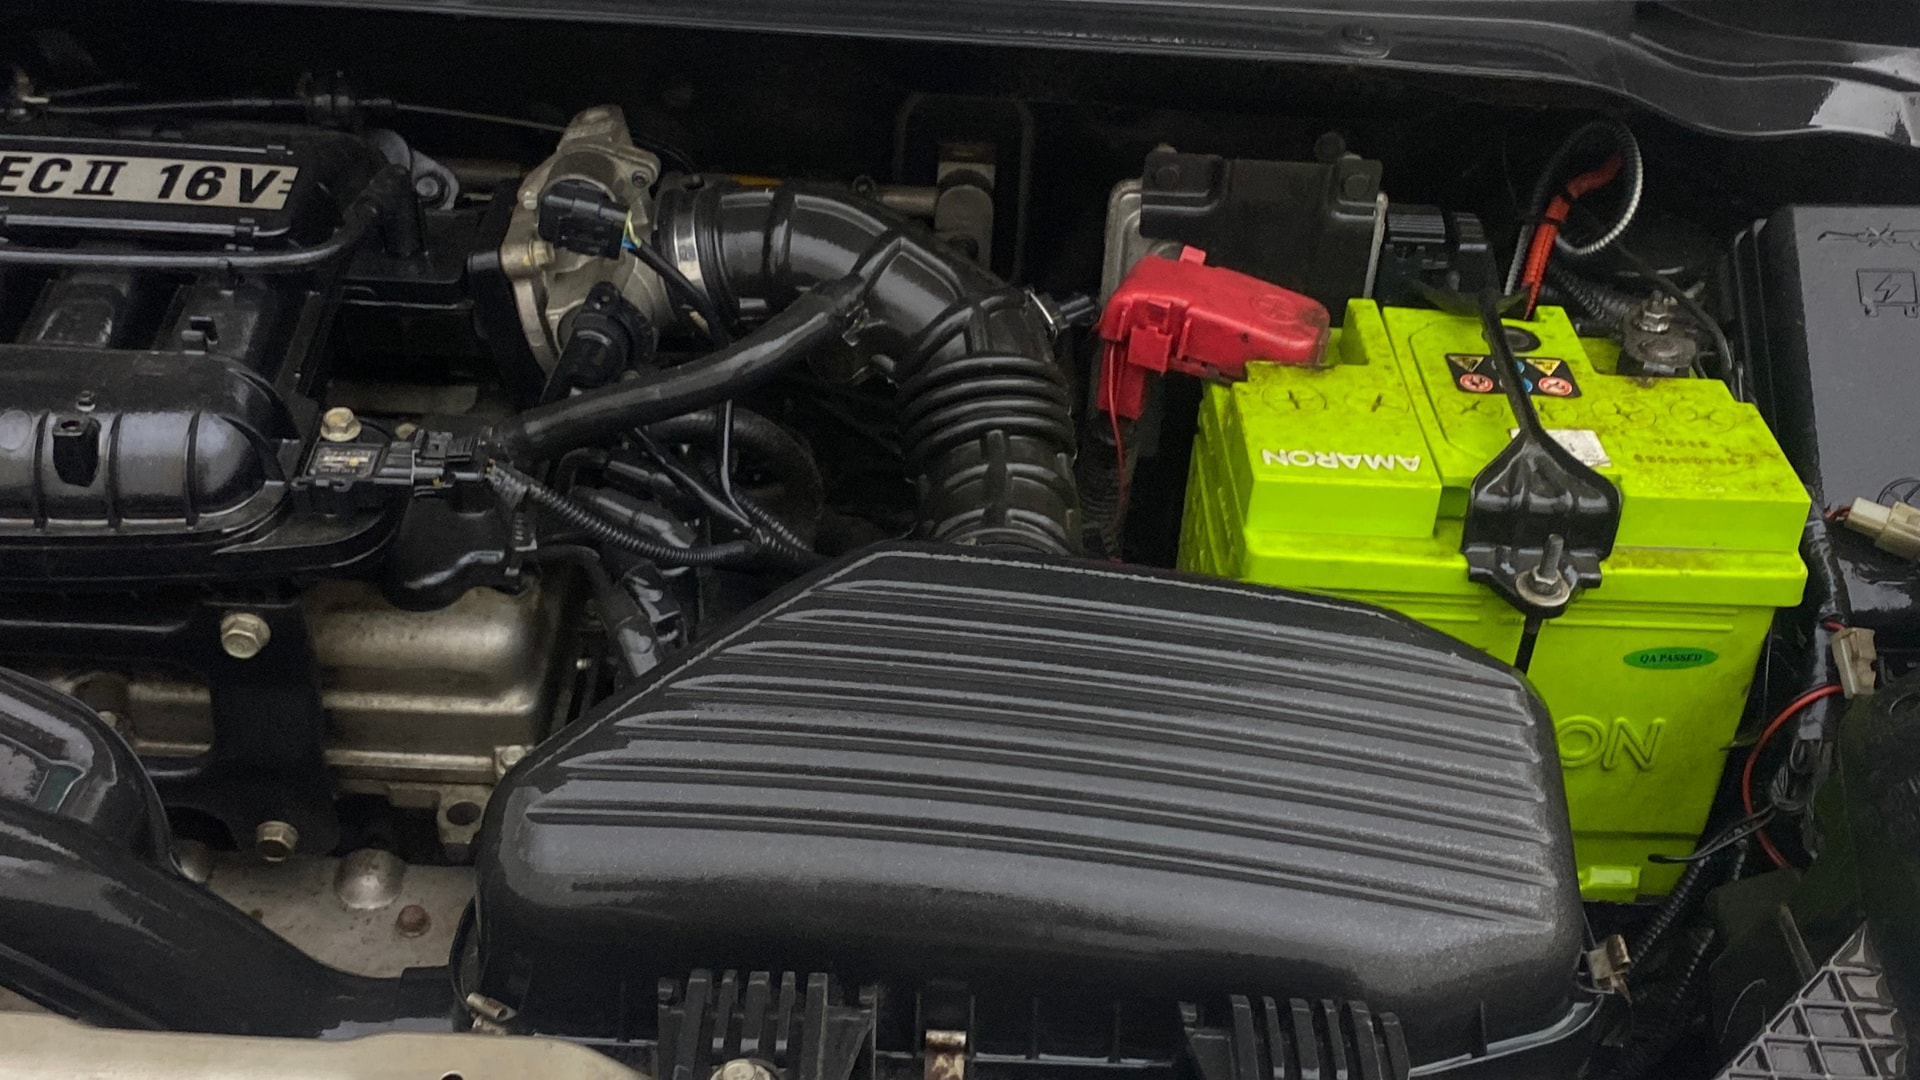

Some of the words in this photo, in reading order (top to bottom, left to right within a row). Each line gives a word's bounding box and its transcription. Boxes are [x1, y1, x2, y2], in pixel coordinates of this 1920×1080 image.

[1262, 449, 1421, 472] AMARON
[1640, 653, 1657, 664] QA
[1659, 653, 1702, 663] PASSED
